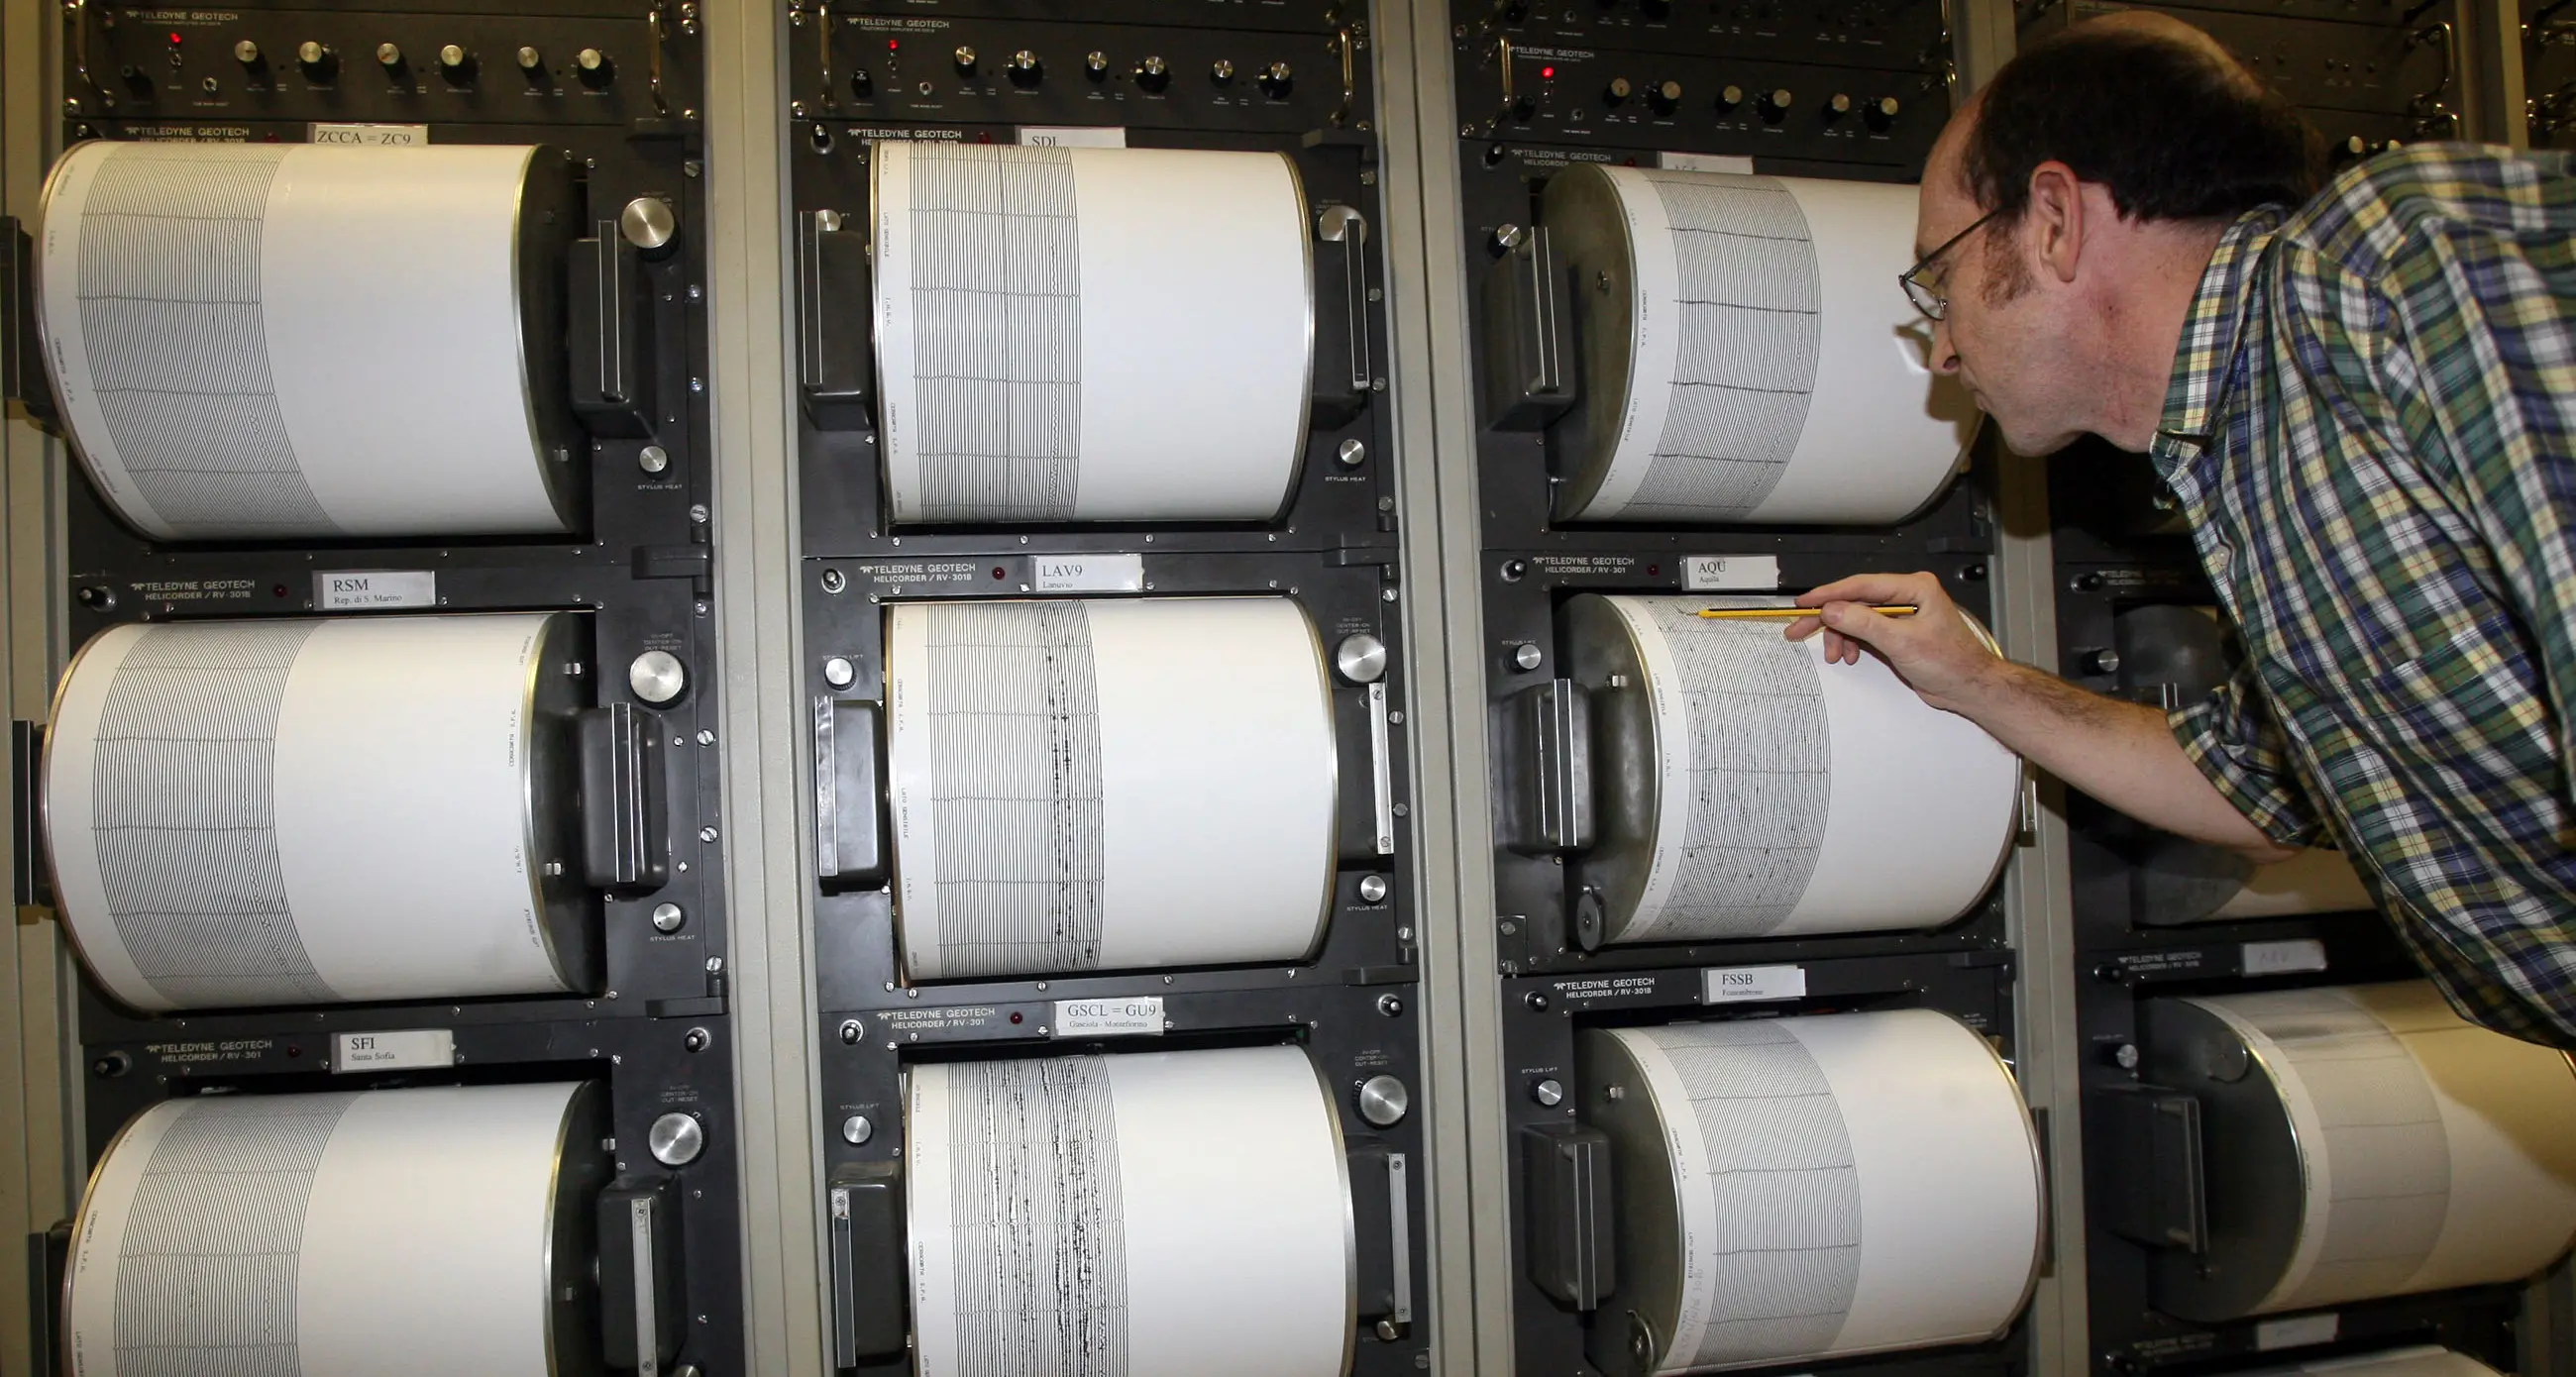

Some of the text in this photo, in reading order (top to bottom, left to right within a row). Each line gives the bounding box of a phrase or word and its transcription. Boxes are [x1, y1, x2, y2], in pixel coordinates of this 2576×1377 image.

[141, 11, 239, 21] TELEDYNE GEOTECH
[907, 20, 950, 29] GEOTECH
[1517, 47, 1554, 56] TELEDYNE
[1557, 50, 1595, 58] GEOTECH
[141, 127, 250, 137] TELEDYNE GEOTECH
[861, 129, 962, 139] TELEDYNE GEOTECH
[317, 131, 363, 145] ZCCA
[381, 132, 411, 146] ZC9
[1524, 150, 1612, 161] TELEDYNE GEOTECH
[1592, 557, 1635, 566] GEOTECH
[874, 563, 976, 574] TELEDYNE GEOTECH
[1042, 565, 1083, 577] LAV9
[1698, 561, 1726, 574] AQU
[873, 574, 926, 583] HELICORDER
[145, 580, 255, 591] TELEDYNE GEOTECH
[333, 579, 369, 592] RSM
[1043, 581, 1073, 589] Lanuvio
[145, 591, 203, 600] HELICORDER
[334, 595, 351, 605] Rep.
[374, 593, 402, 603] Marino
[1566, 978, 1656, 991] TELEDYNE GEOTECH
[1721, 974, 1754, 986] FSSB
[1566, 990, 1612, 1000] HELICORDER
[892, 1007, 996, 1020] TELEDYNE GEOTECH
[1067, 1005, 1109, 1017] GSCL
[1126, 1003, 1156, 1016] GU9
[892, 1019, 944, 1029] HELICORDER
[161, 1040, 272, 1053] TELEDYNE GEOTECH
[351, 1037, 376, 1051] SFI
[161, 1052, 218, 1063] HELICORDER
[351, 1051, 395, 1062] Santa Sofia
